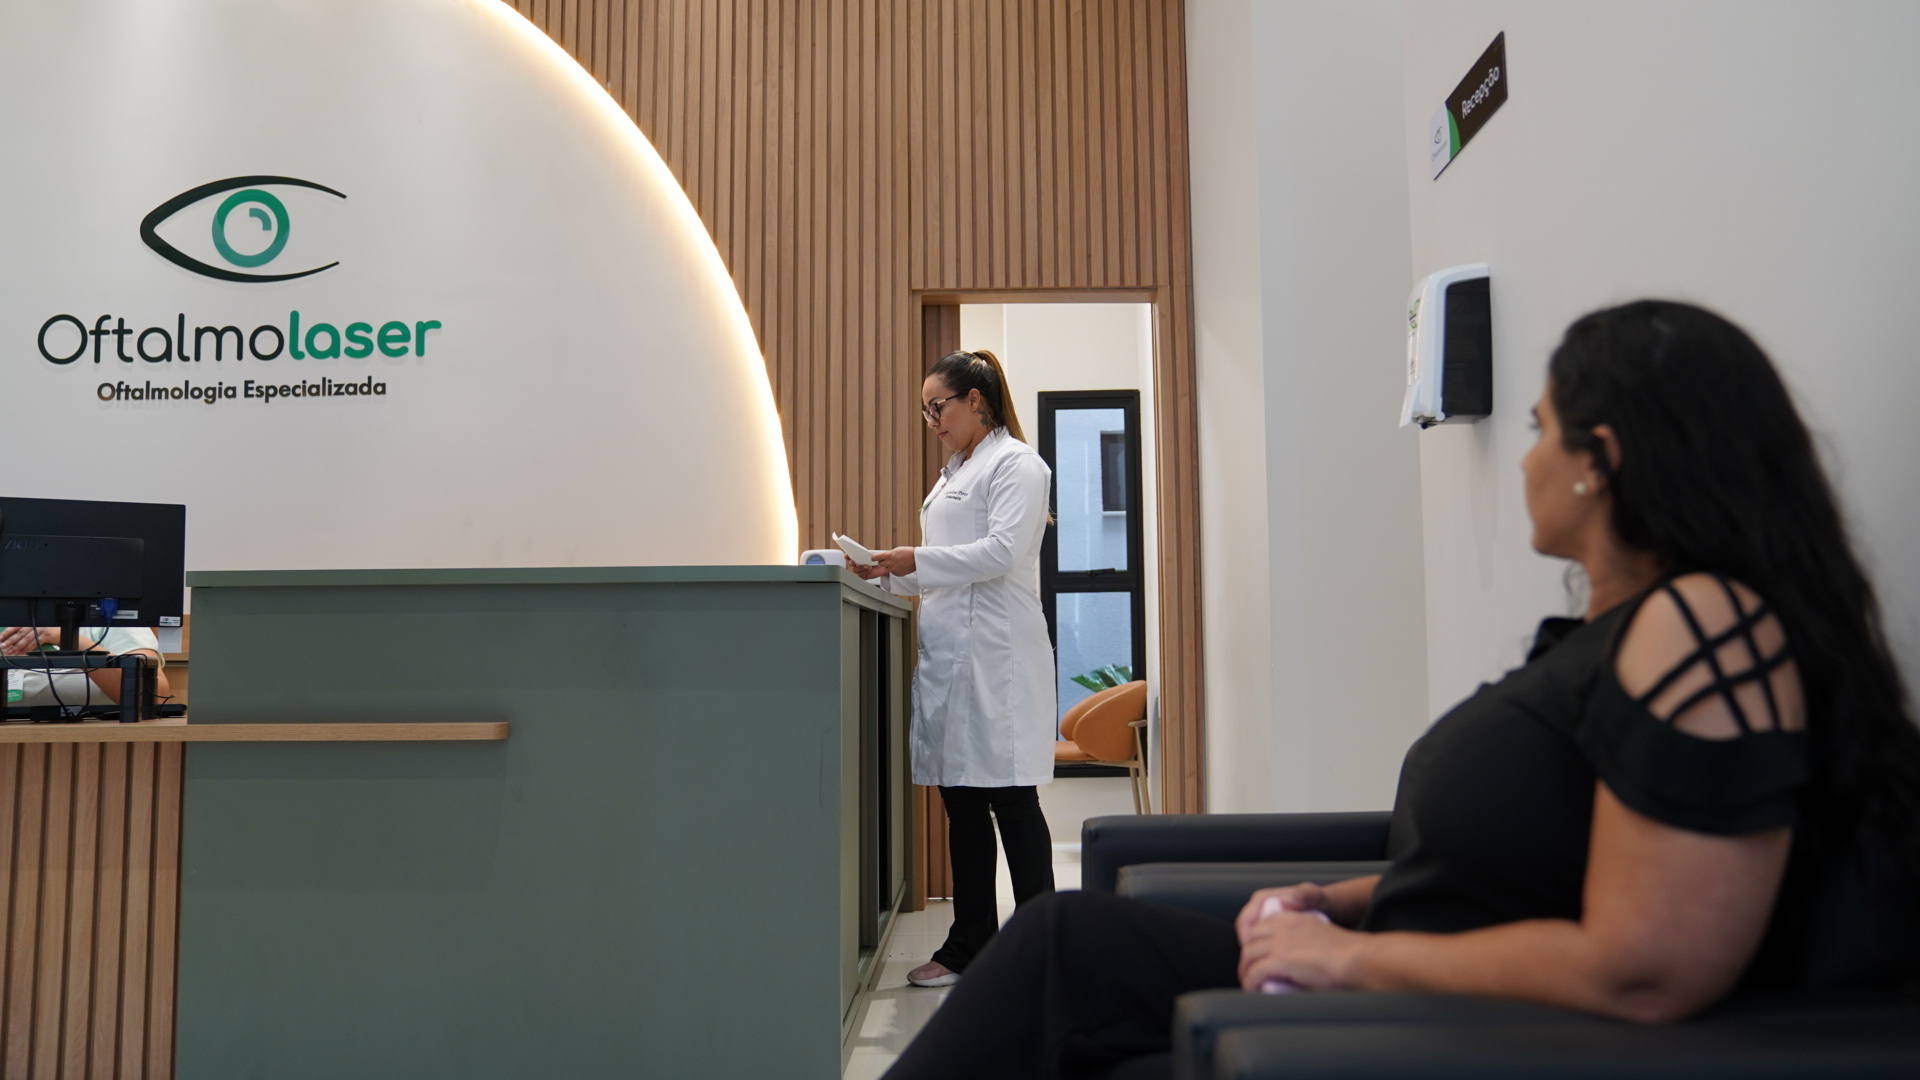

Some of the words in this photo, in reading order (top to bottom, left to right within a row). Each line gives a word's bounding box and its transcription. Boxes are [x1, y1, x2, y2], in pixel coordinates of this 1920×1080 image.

[1462, 66, 1499, 119] Recepção
[38, 310, 442, 365] Oftalmolaser
[97, 380, 237, 404] Oftalmologia
[243, 376, 387, 403] Especializada
